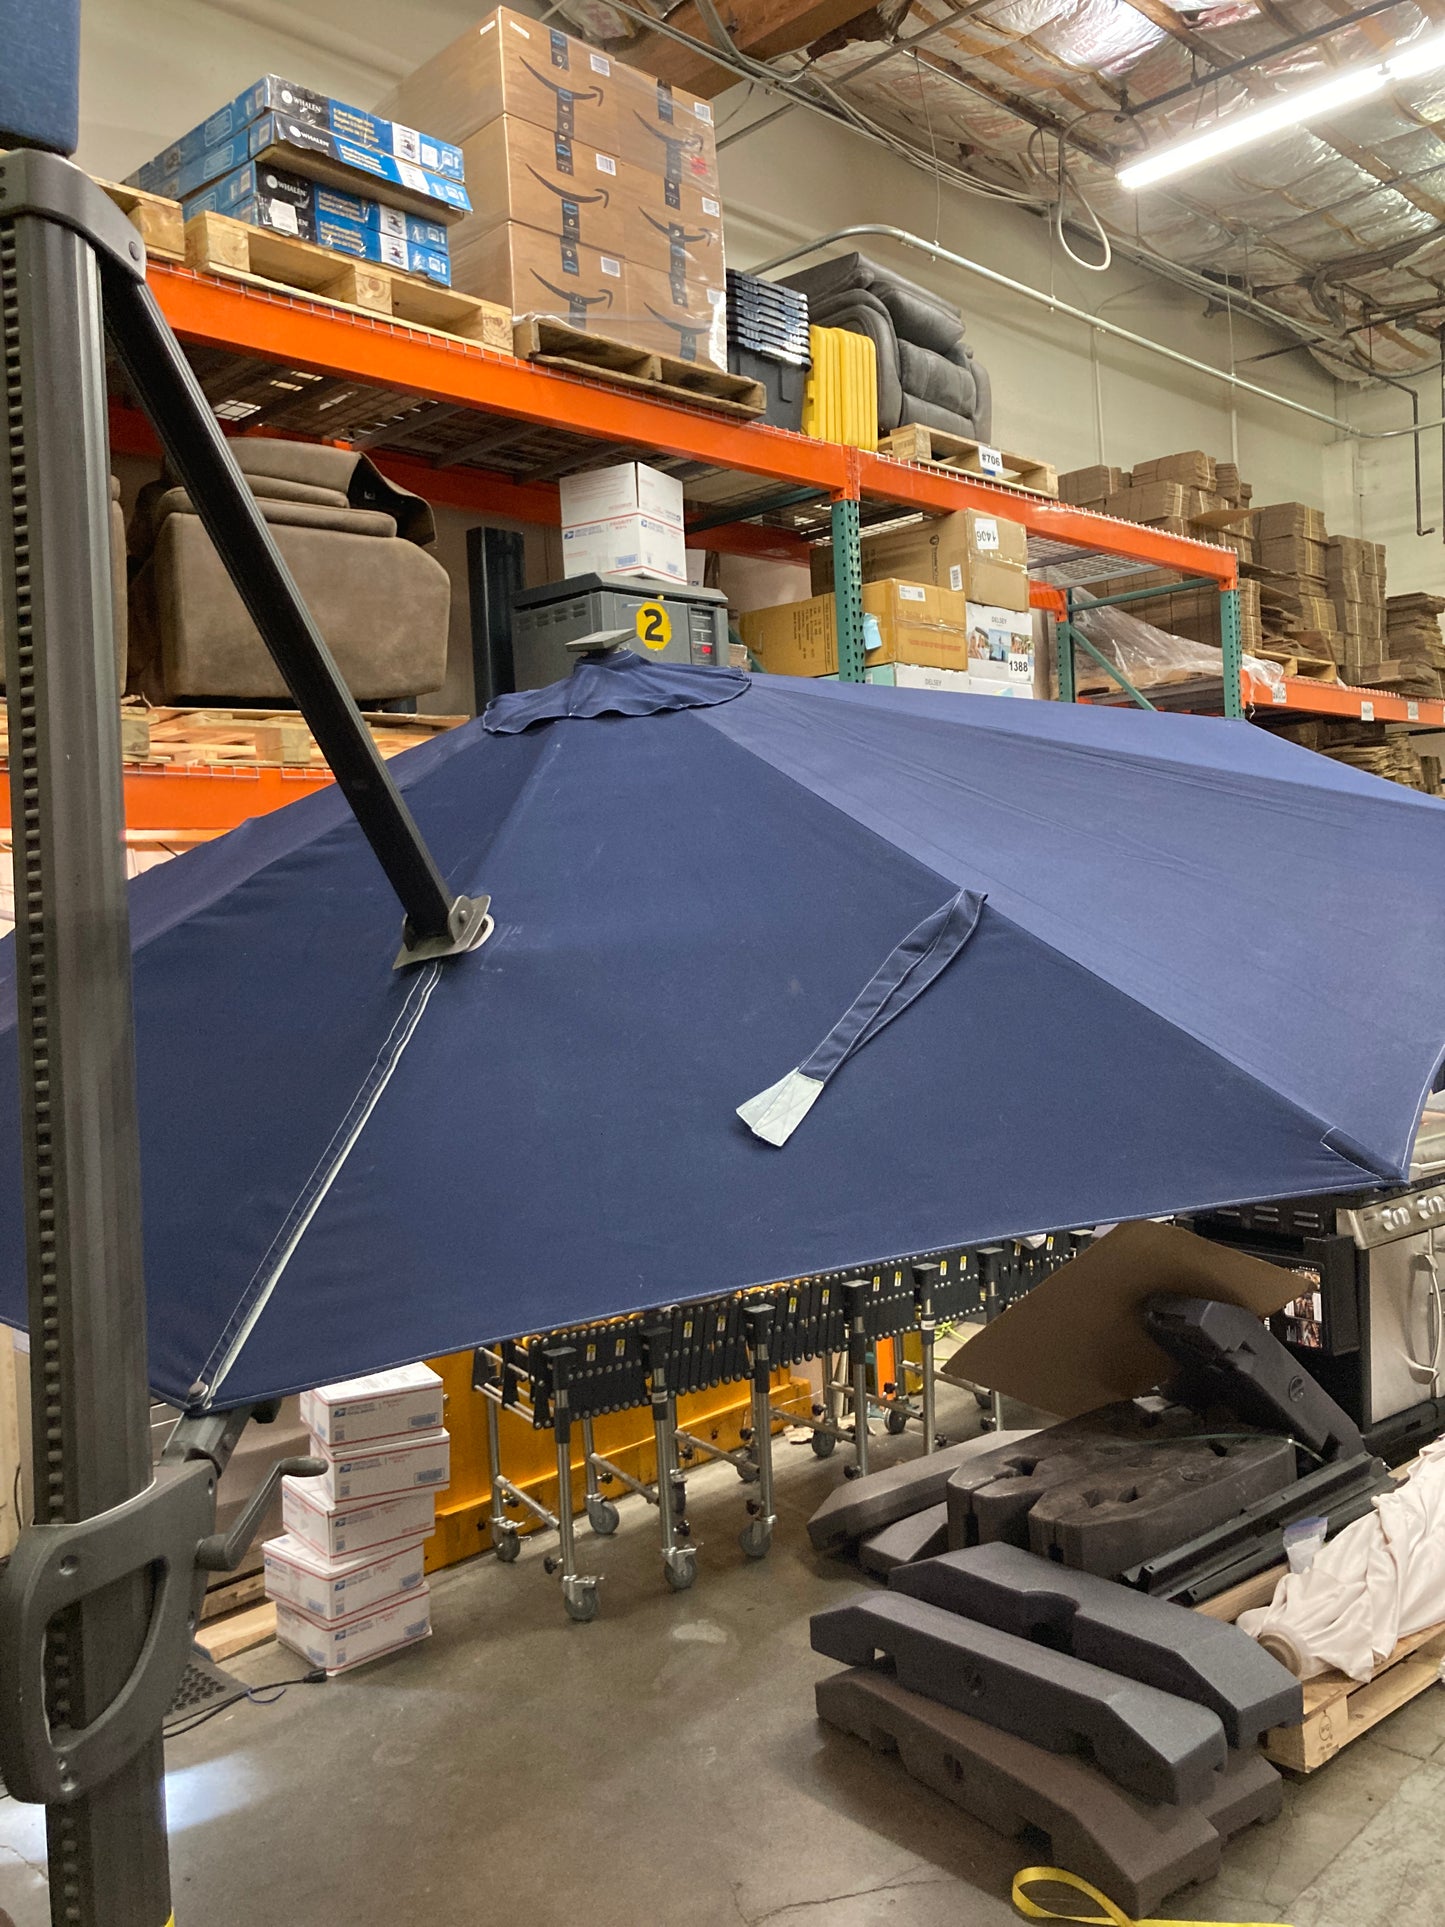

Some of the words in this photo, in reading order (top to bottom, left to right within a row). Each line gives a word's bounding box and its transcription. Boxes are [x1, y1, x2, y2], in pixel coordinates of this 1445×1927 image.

[293, 96, 322, 113] WHALEN
[300, 131, 330, 147] WHALEN
[277, 181, 307, 197] WHALEN
[981, 453, 1001, 467] #706
[976, 530, 997, 542] 1406
[643, 608, 664, 642] 2
[1009, 660, 1028, 672] 1388
